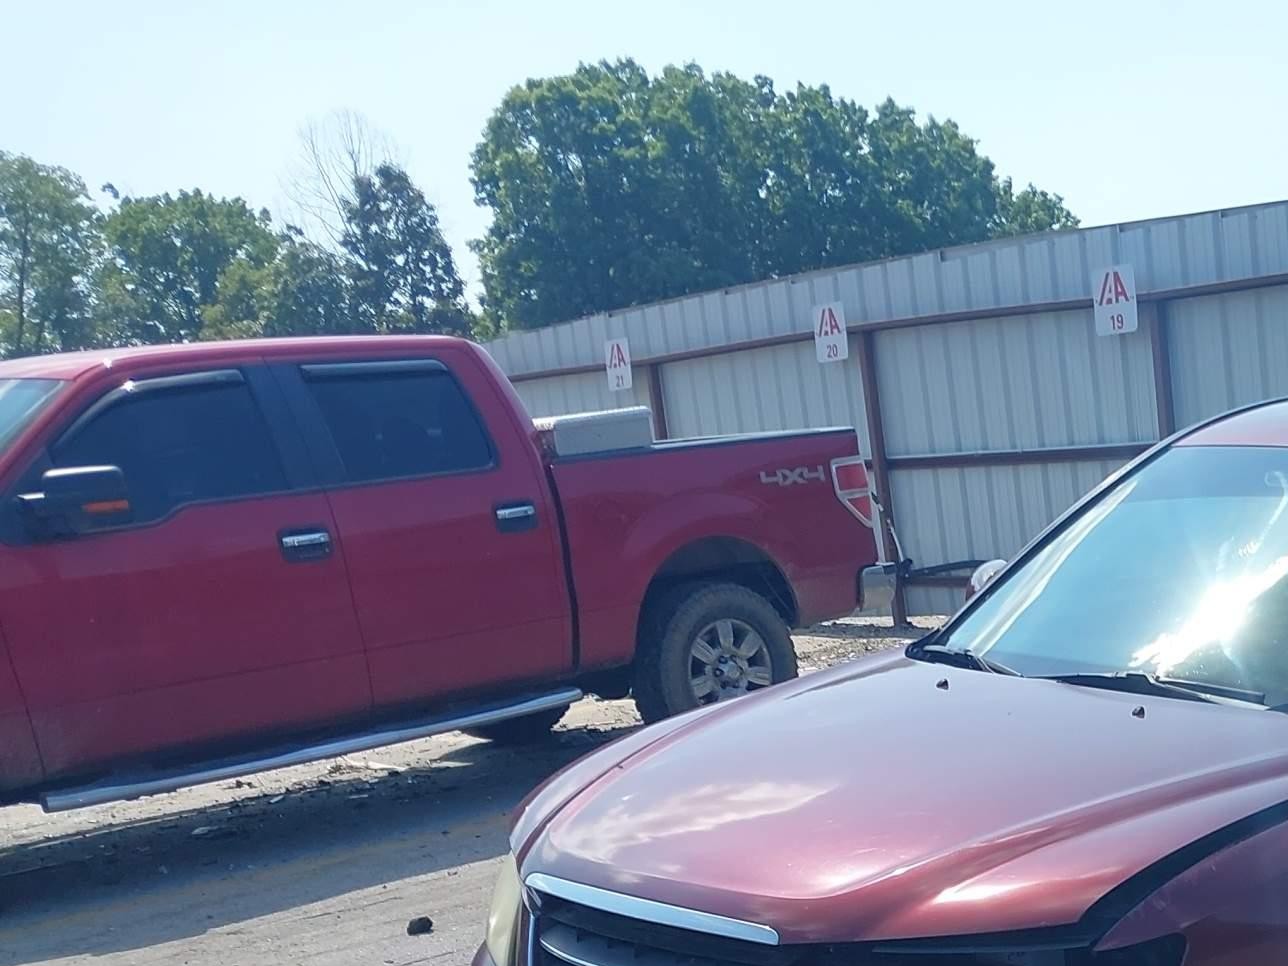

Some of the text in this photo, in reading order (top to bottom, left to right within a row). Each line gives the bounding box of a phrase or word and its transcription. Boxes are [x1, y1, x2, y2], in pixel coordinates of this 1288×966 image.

[1110, 313, 1124, 330] 19
[826, 343, 838, 358] 20
[616, 375, 625, 388] 21
